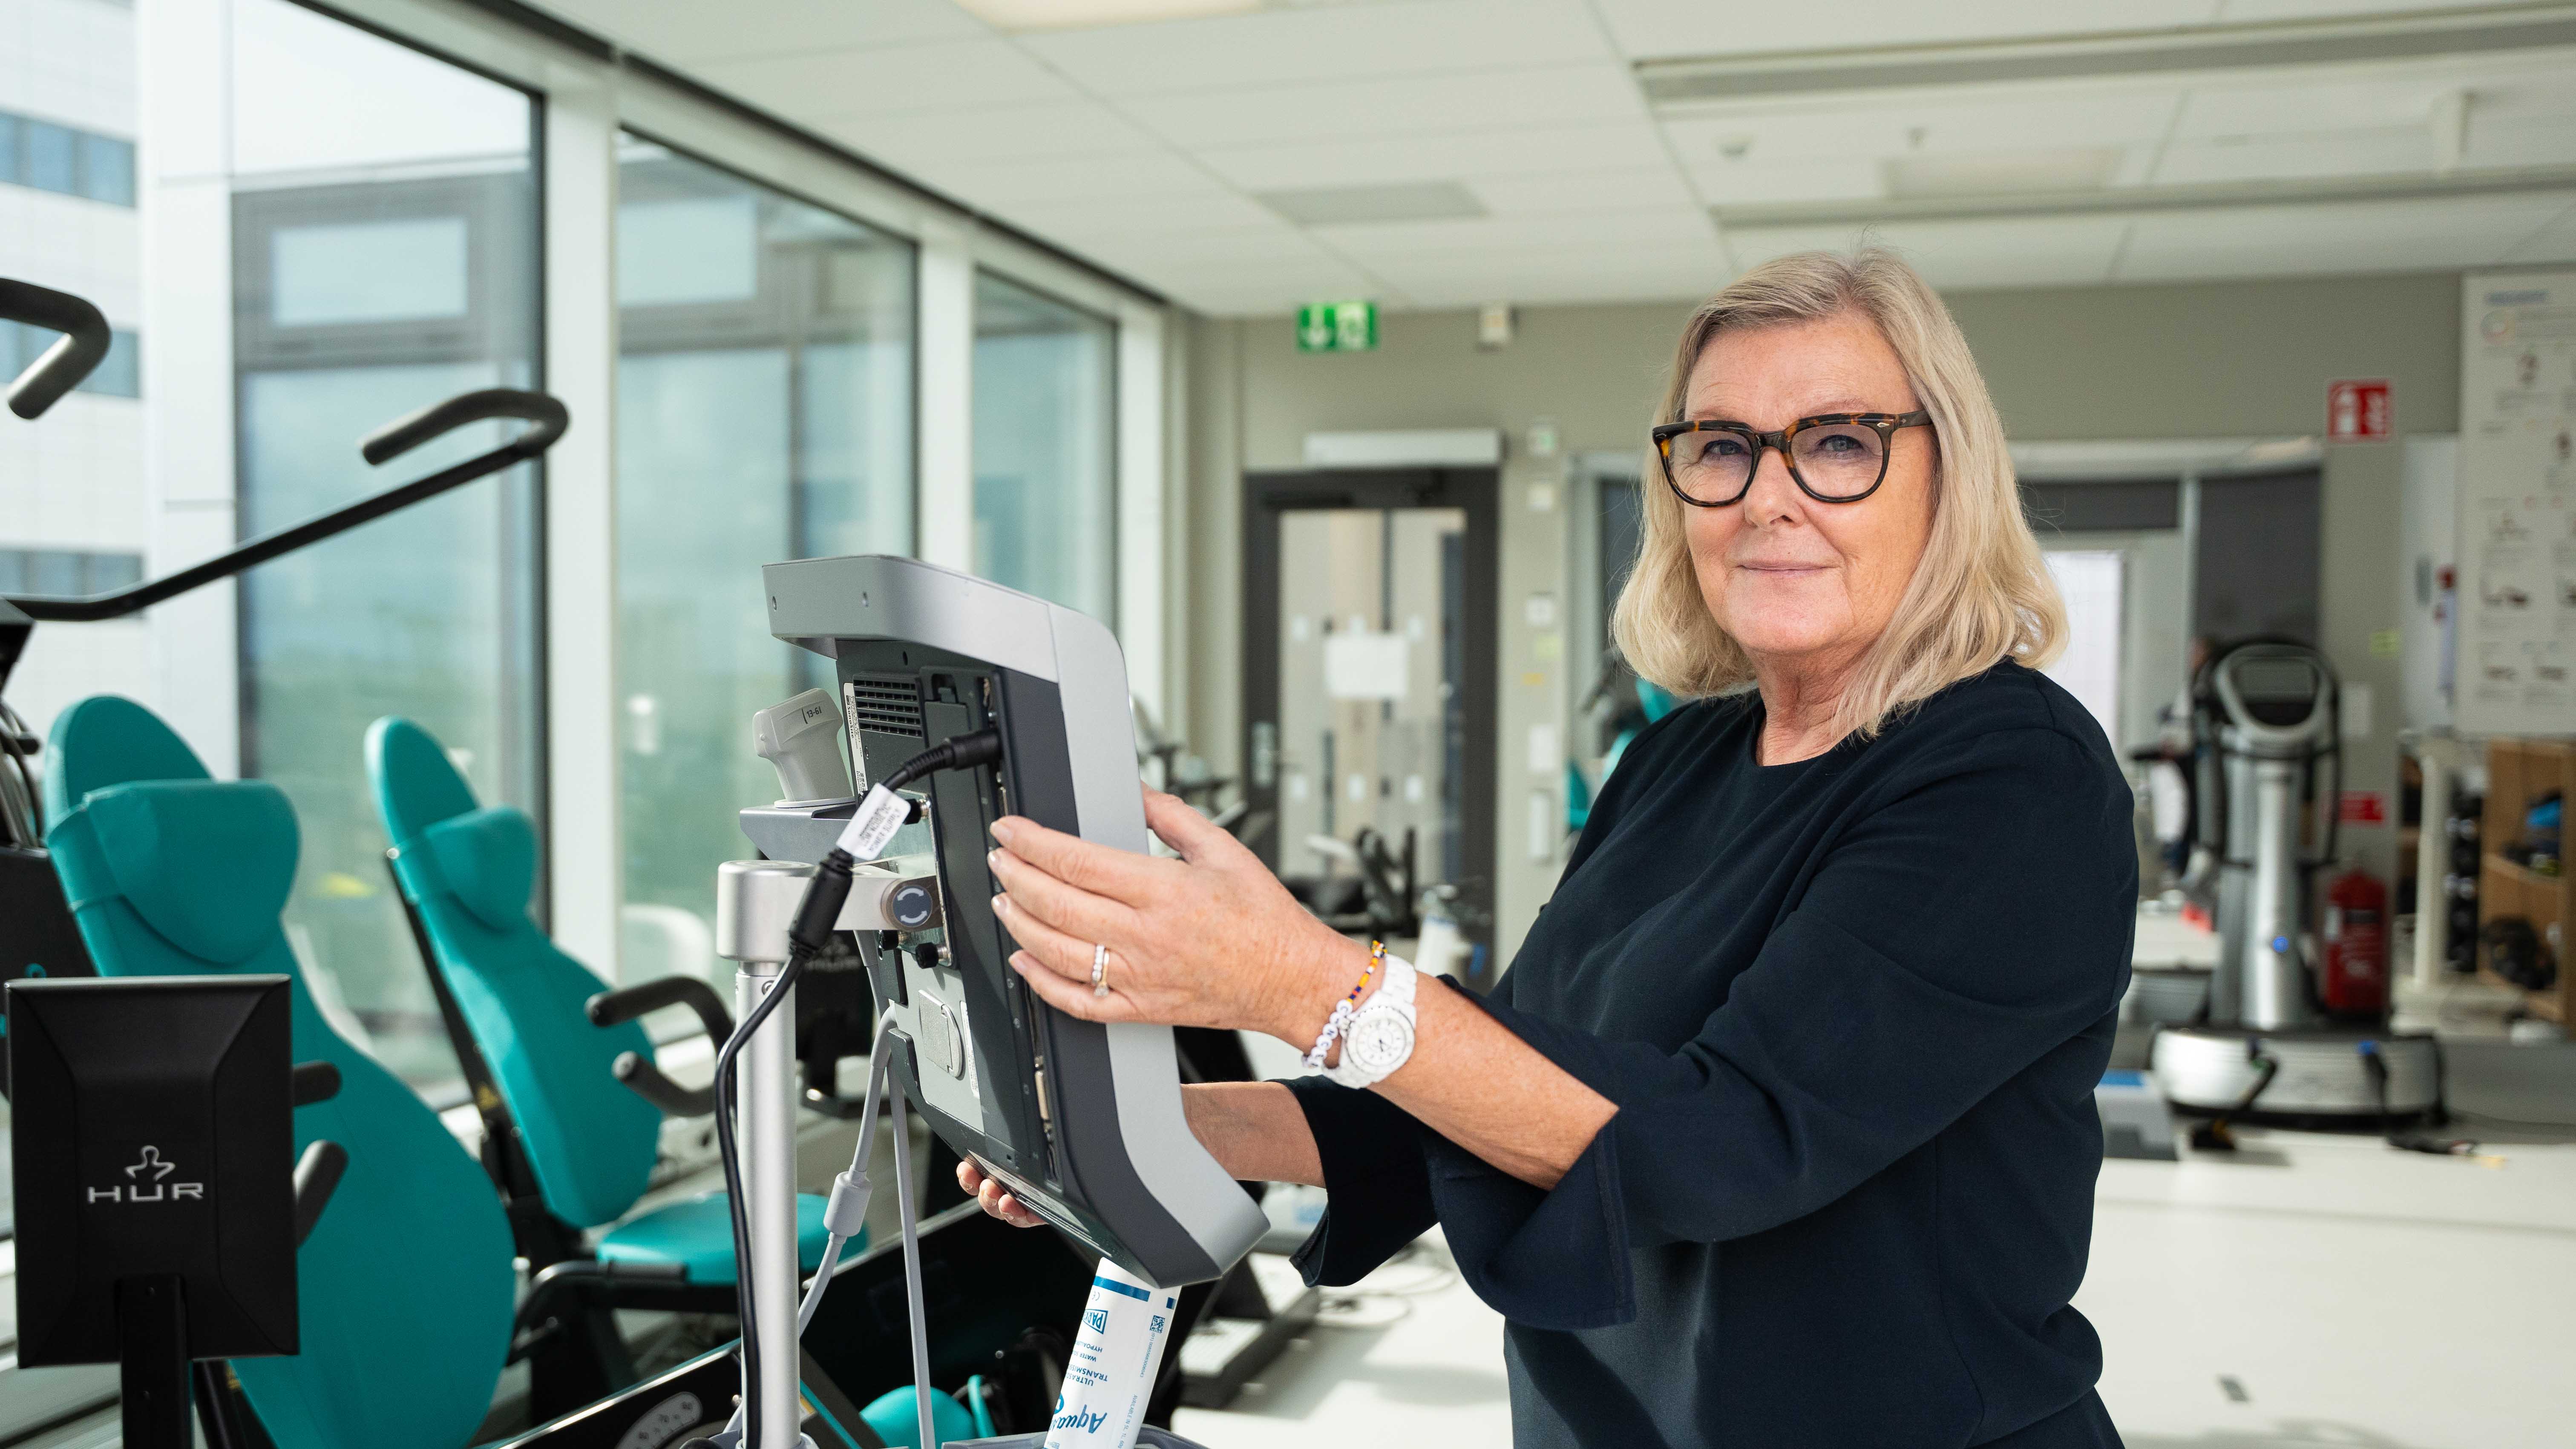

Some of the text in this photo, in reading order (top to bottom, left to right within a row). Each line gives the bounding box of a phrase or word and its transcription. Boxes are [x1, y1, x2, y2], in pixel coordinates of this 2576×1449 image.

[87, 1183, 204, 1204] HUR
[1079, 1352, 1096, 1362] WATER
[1127, 1394, 1138, 1418] AVAILABLE
